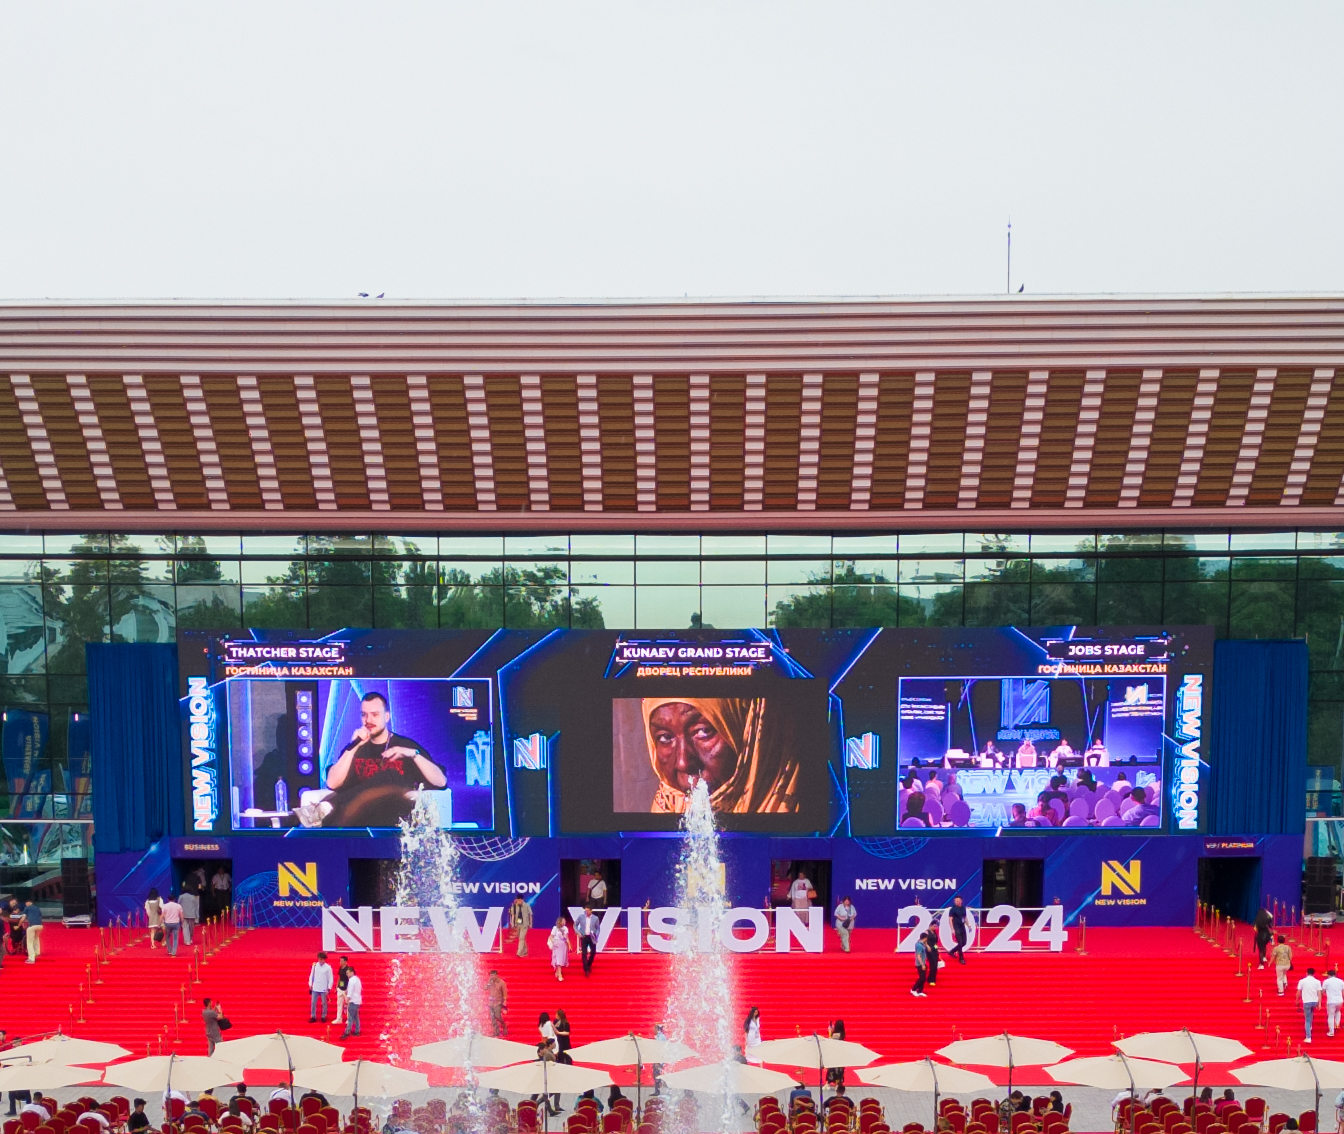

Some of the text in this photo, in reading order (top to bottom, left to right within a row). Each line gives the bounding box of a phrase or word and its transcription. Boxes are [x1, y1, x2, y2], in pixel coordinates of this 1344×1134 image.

[230, 648, 339, 658] THATCHER STAGE
[624, 648, 765, 658] KUNAEV GRAND STAGE
[1068, 645, 1144, 655] JOBS STAGE
[292, 667, 353, 676] КАЗАХСТАН
[637, 667, 751, 677] ДВОРЕЦ РЕСПУБЛИКИ
[1104, 664, 1166, 673] КАЗАХСТАН
[188, 677, 215, 831] NEW VISION
[1176, 675, 1202, 829] NEW VISION
[278, 862, 318, 896] N
[1101, 860, 1140, 895] N
[482, 882, 540, 894] VISION
[856, 878, 956, 890] NEW VISION
[322, 906, 504, 952] NEW
[897, 904, 1068, 952] 2024
